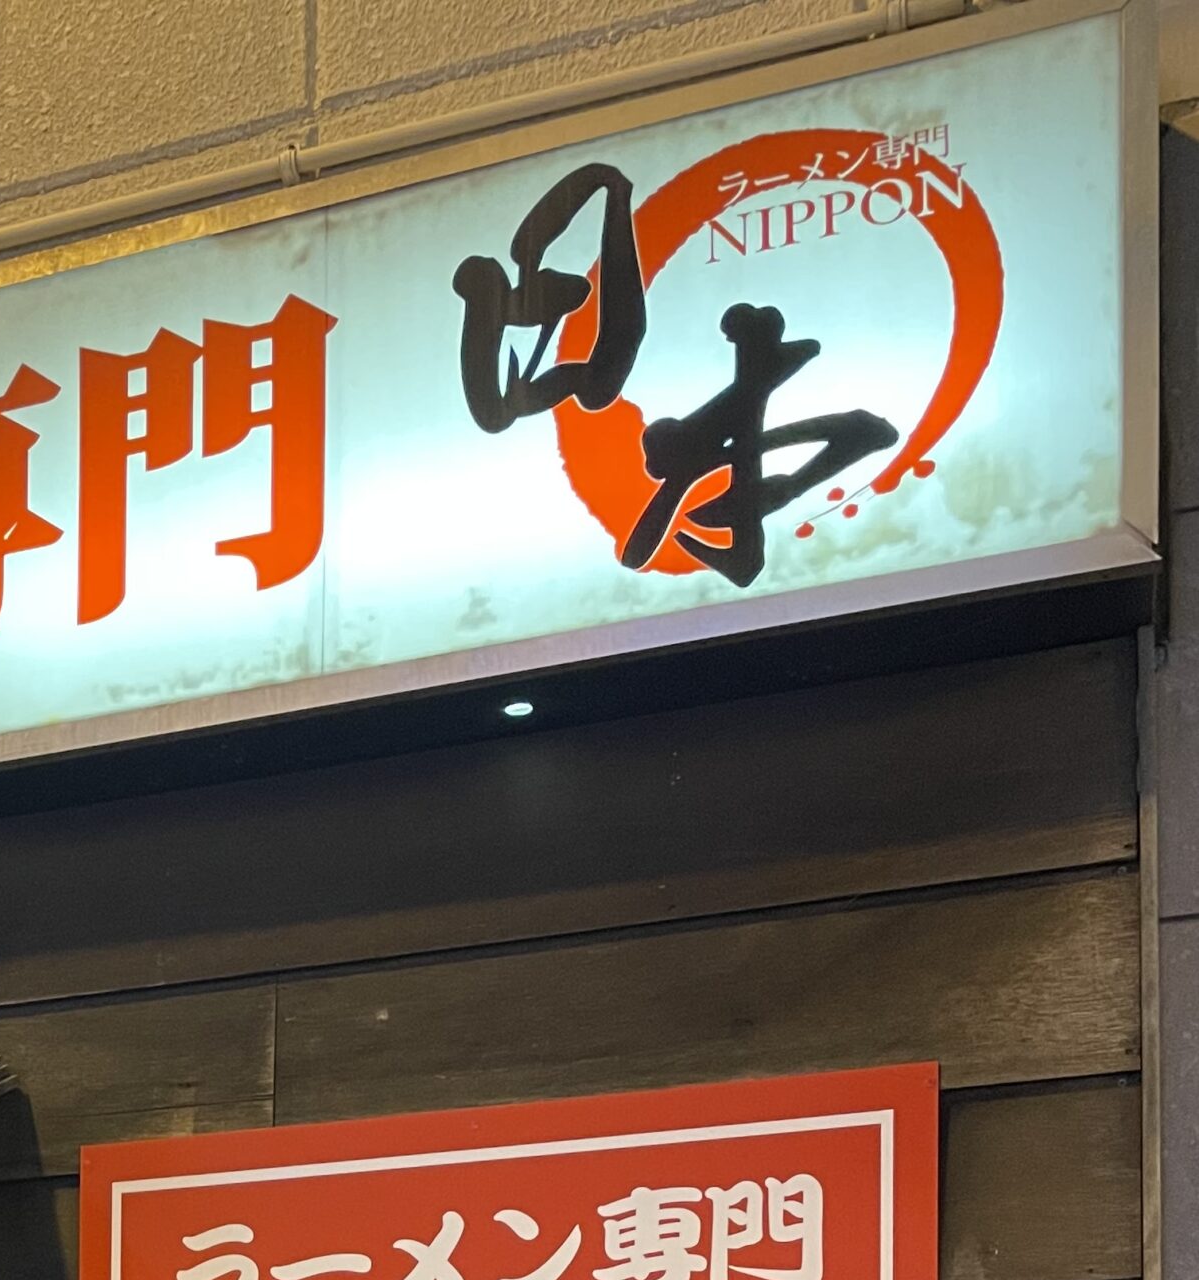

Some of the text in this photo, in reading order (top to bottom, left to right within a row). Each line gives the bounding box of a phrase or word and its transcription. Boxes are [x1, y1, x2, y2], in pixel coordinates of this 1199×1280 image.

[717, 123, 949, 208] ラーメン専門
[705, 162, 968, 264] NIPPON
